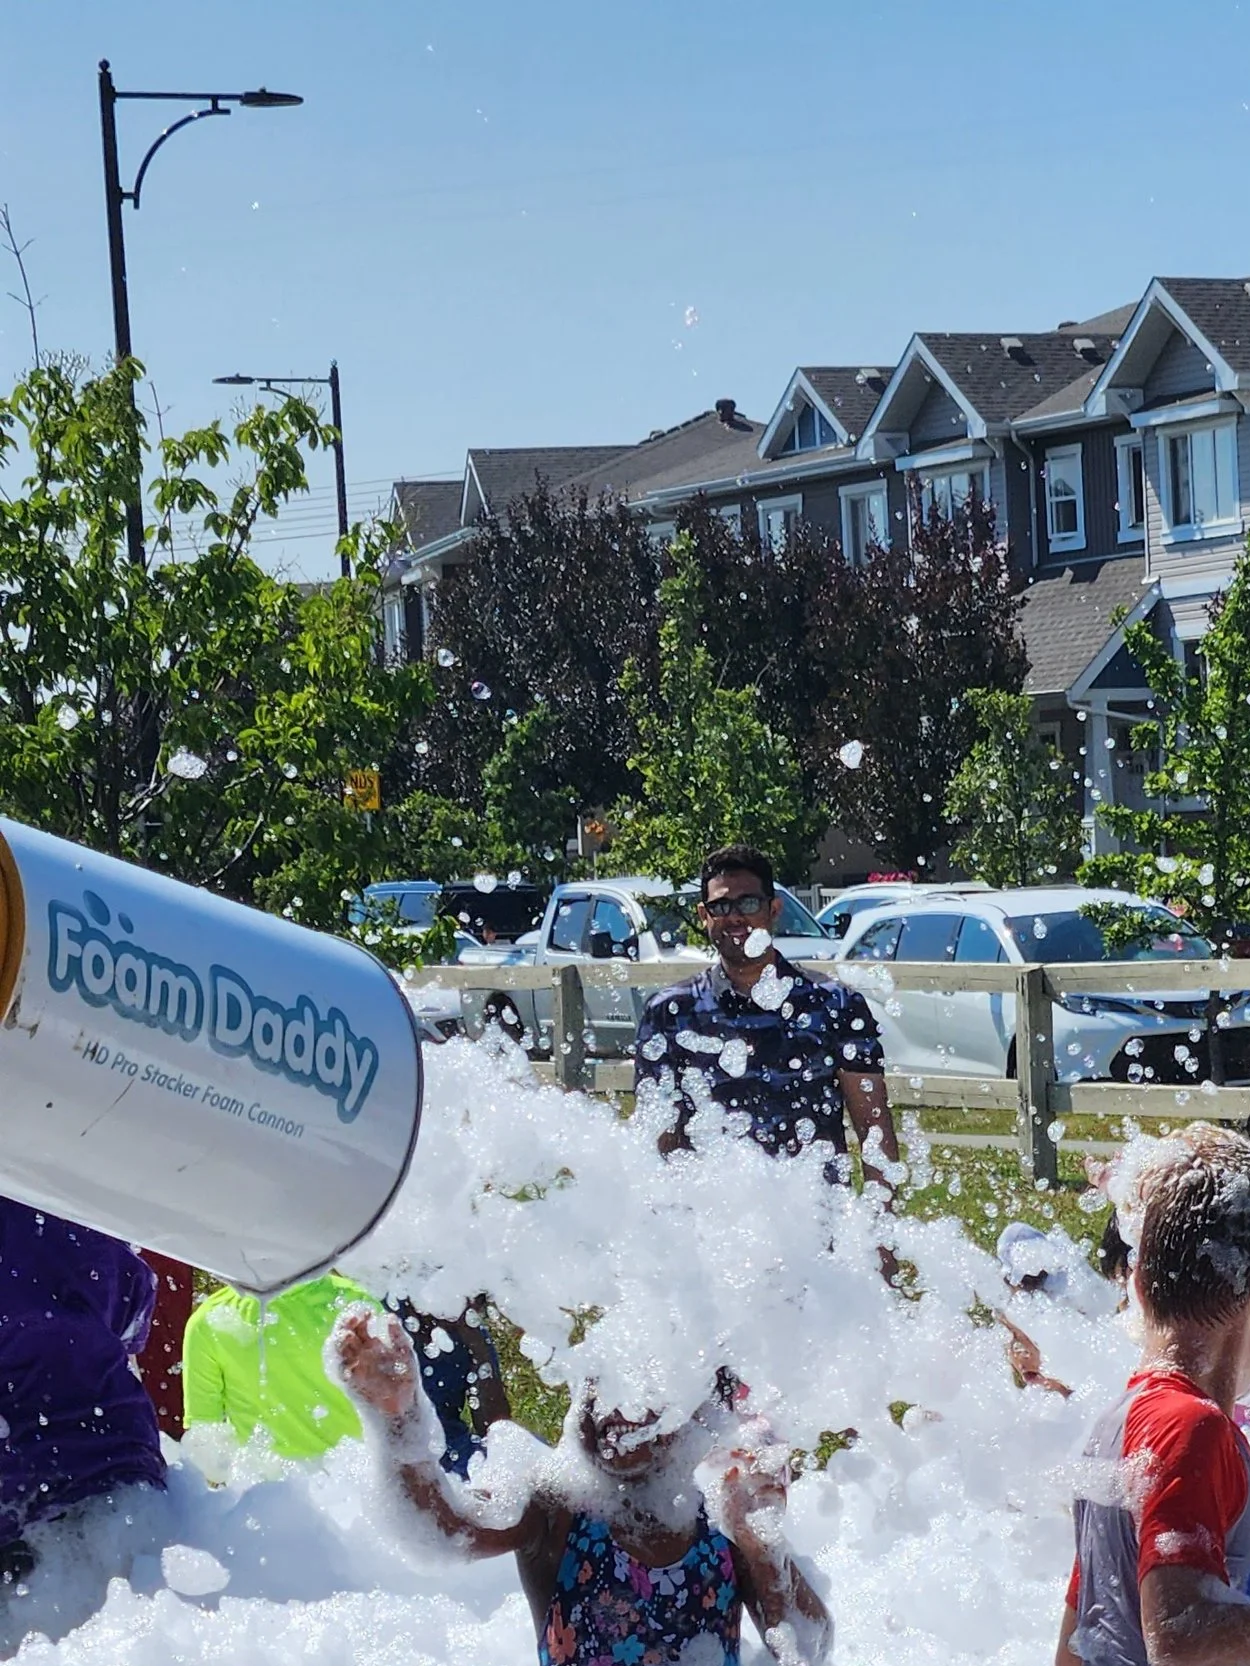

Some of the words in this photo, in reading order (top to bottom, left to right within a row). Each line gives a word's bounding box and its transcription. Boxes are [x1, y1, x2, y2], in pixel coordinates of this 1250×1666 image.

[50, 902, 202, 1042] Foam
[210, 965, 378, 1122] Daddy
[82, 1041, 109, 1066] HD
[112, 1052, 139, 1077] Pro
[141, 1064, 200, 1099] Stacker
[202, 1085, 244, 1116] Foam
[248, 1103, 304, 1138] Cannon
